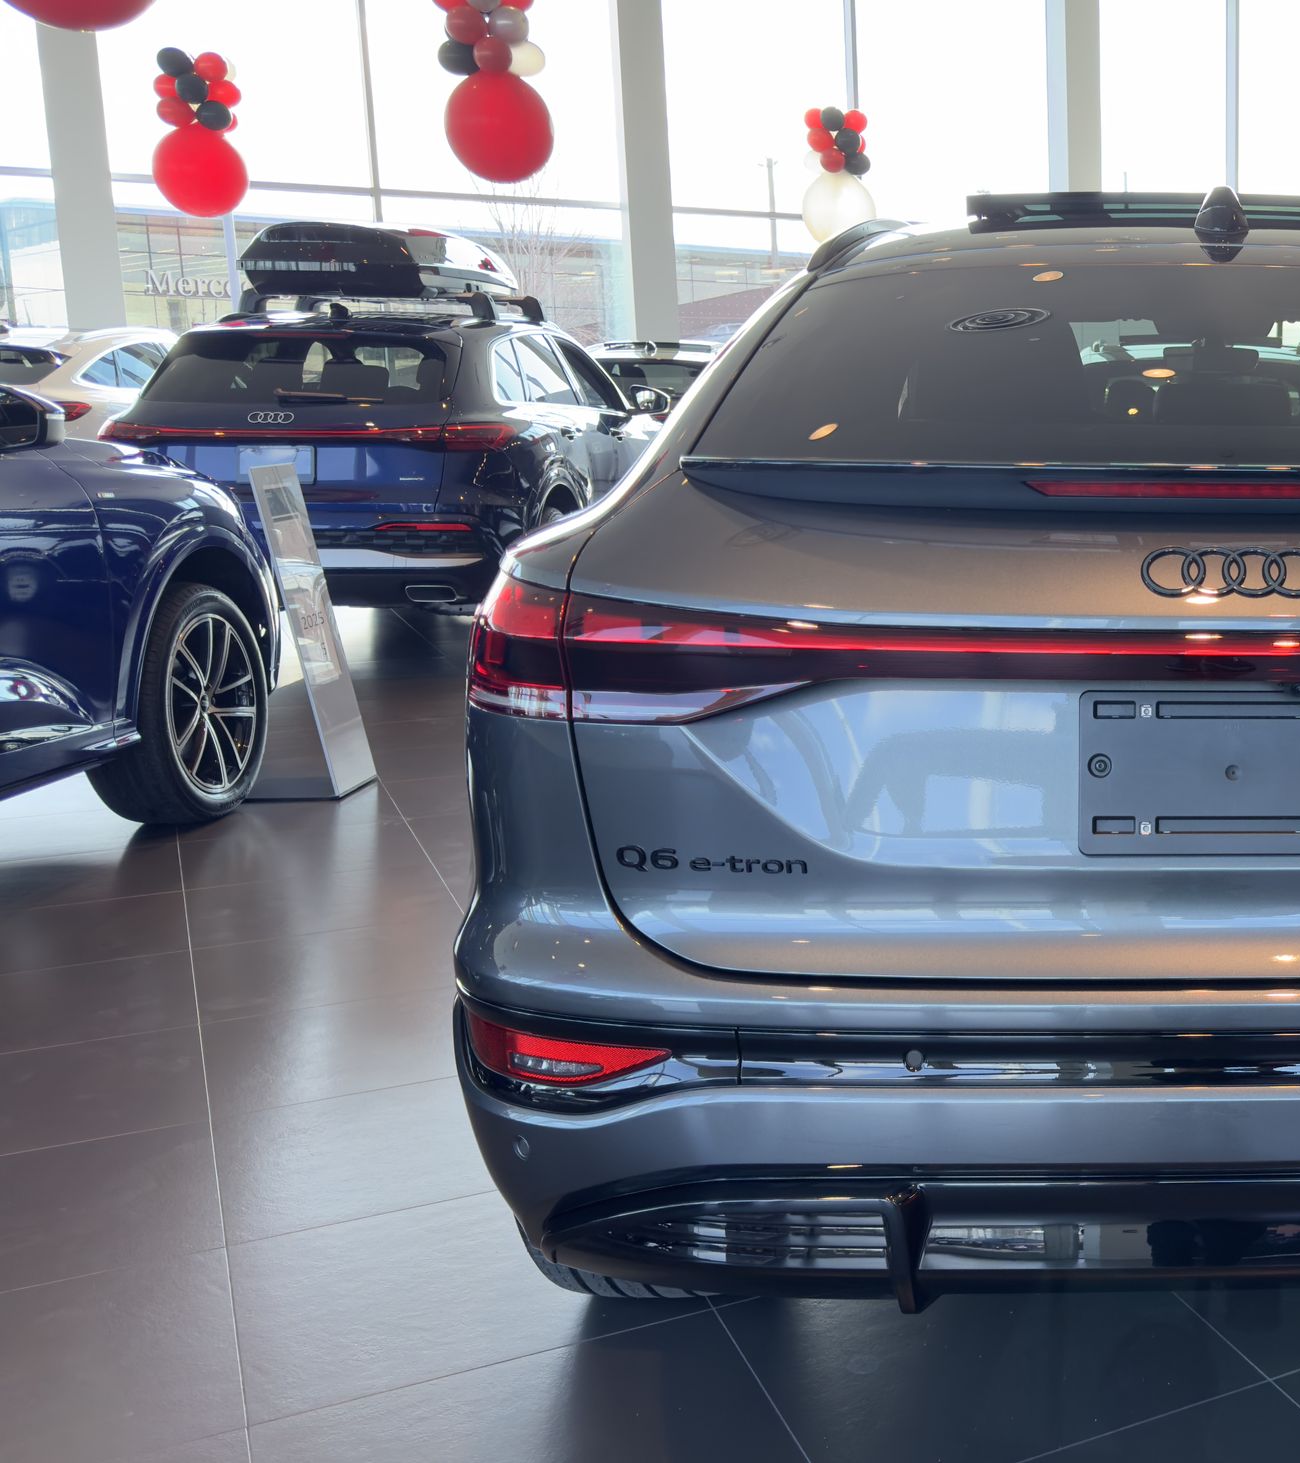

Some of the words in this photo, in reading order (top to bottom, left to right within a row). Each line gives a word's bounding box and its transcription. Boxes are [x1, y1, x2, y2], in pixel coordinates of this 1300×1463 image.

[301, 611, 325, 630] 2025
[616, 845, 679, 873] Q6
[689, 855, 809, 874] e-tron
